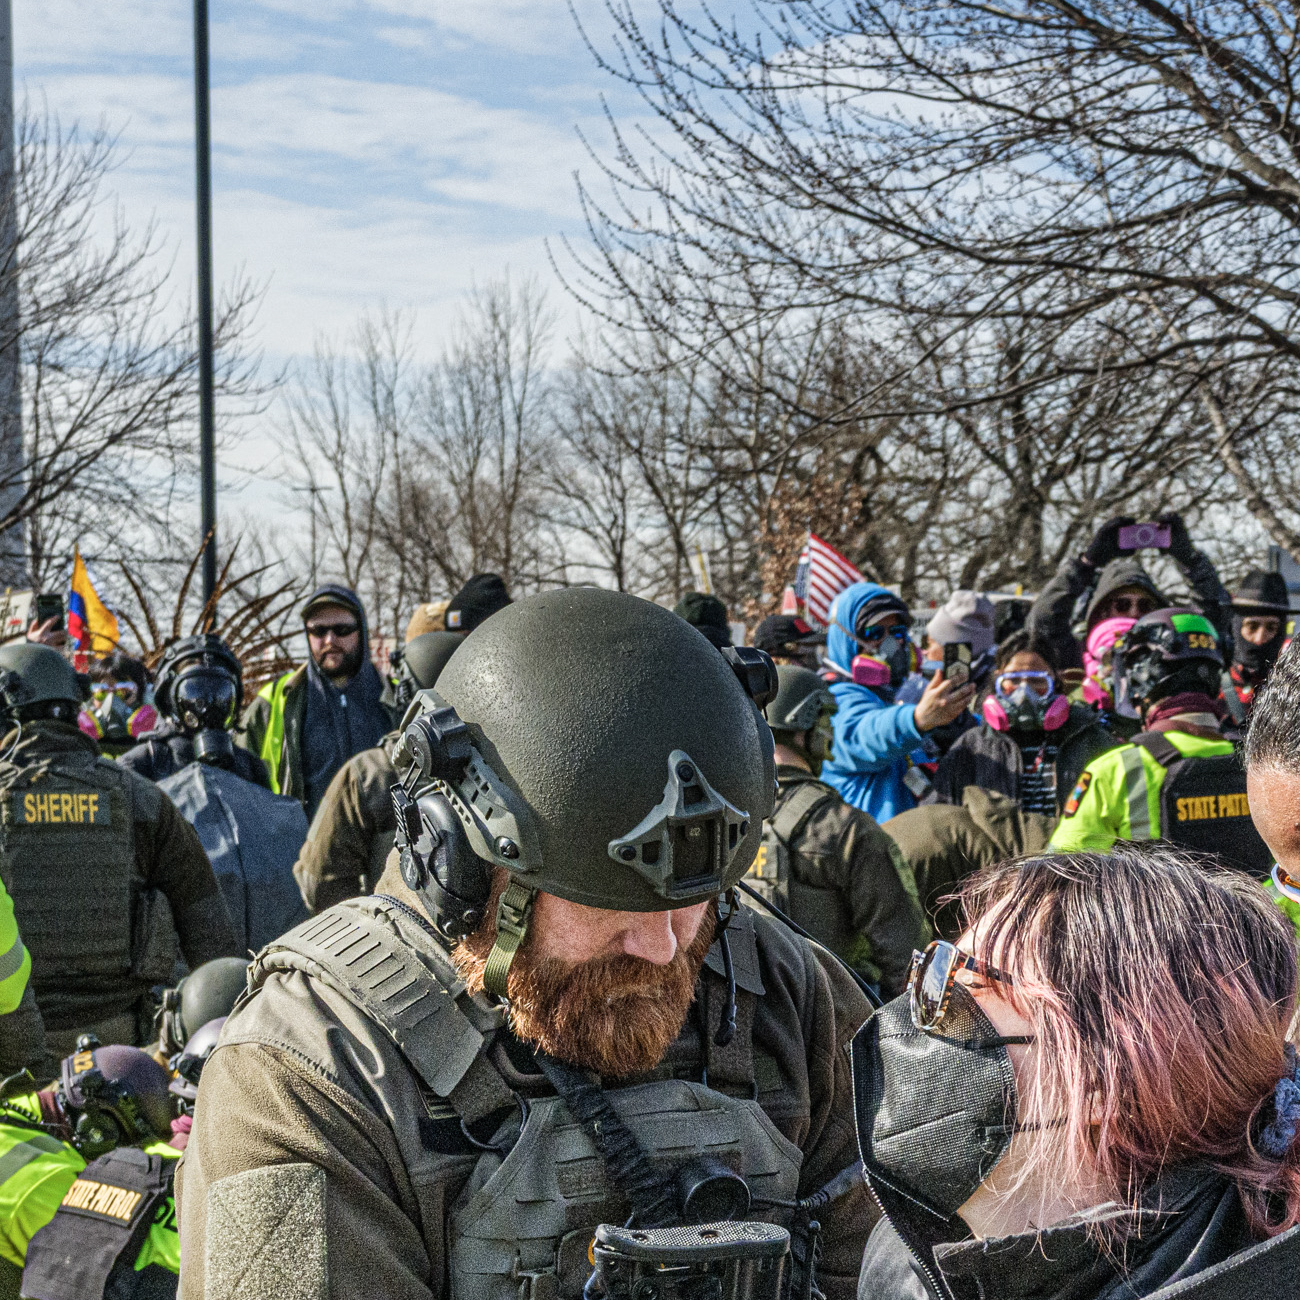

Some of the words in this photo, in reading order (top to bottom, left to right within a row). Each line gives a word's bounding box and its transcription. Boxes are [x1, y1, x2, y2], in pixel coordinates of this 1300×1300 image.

[24, 793, 99, 823] SHERIFF
[1176, 795, 1218, 821] STATE
[62, 1179, 100, 1210] STATE
[89, 1184, 142, 1222] PATROL
